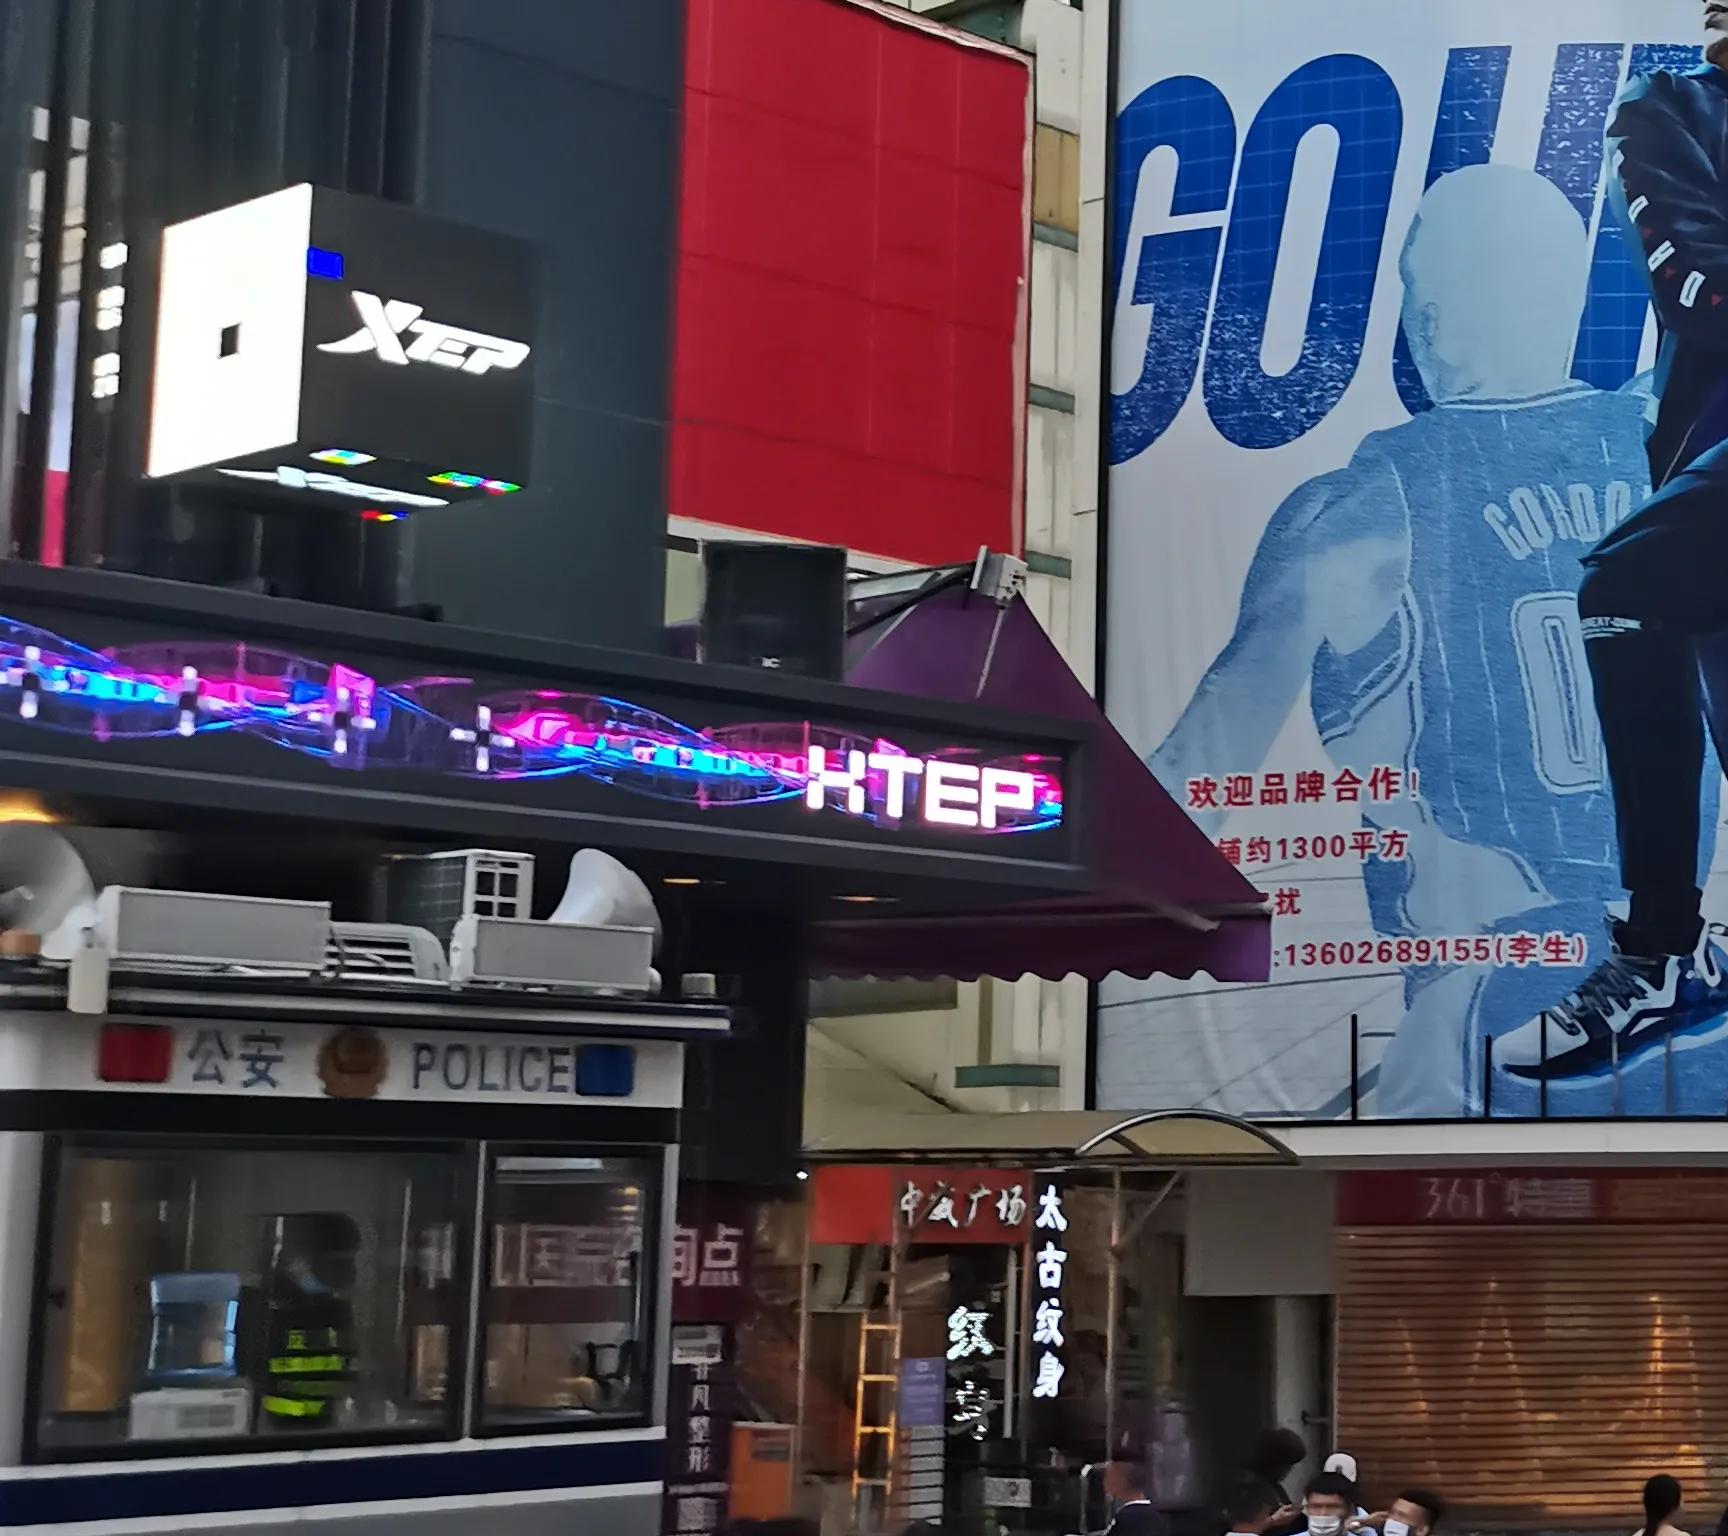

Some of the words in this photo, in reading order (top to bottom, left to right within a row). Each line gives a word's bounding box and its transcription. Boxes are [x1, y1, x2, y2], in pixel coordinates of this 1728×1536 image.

[1108, 52, 1403, 467] GO
[316, 289, 531, 376] XTEP
[803, 741, 1037, 830] XTEP
[1186, 768, 1420, 809] 欢迎品牌合作!
[187, 1028, 286, 1090] 公安
[411, 1041, 572, 1095] POLICE
[900, 1180, 1027, 1229] 中威广场
[1032, 1183, 1068, 1399] 太古纹身
